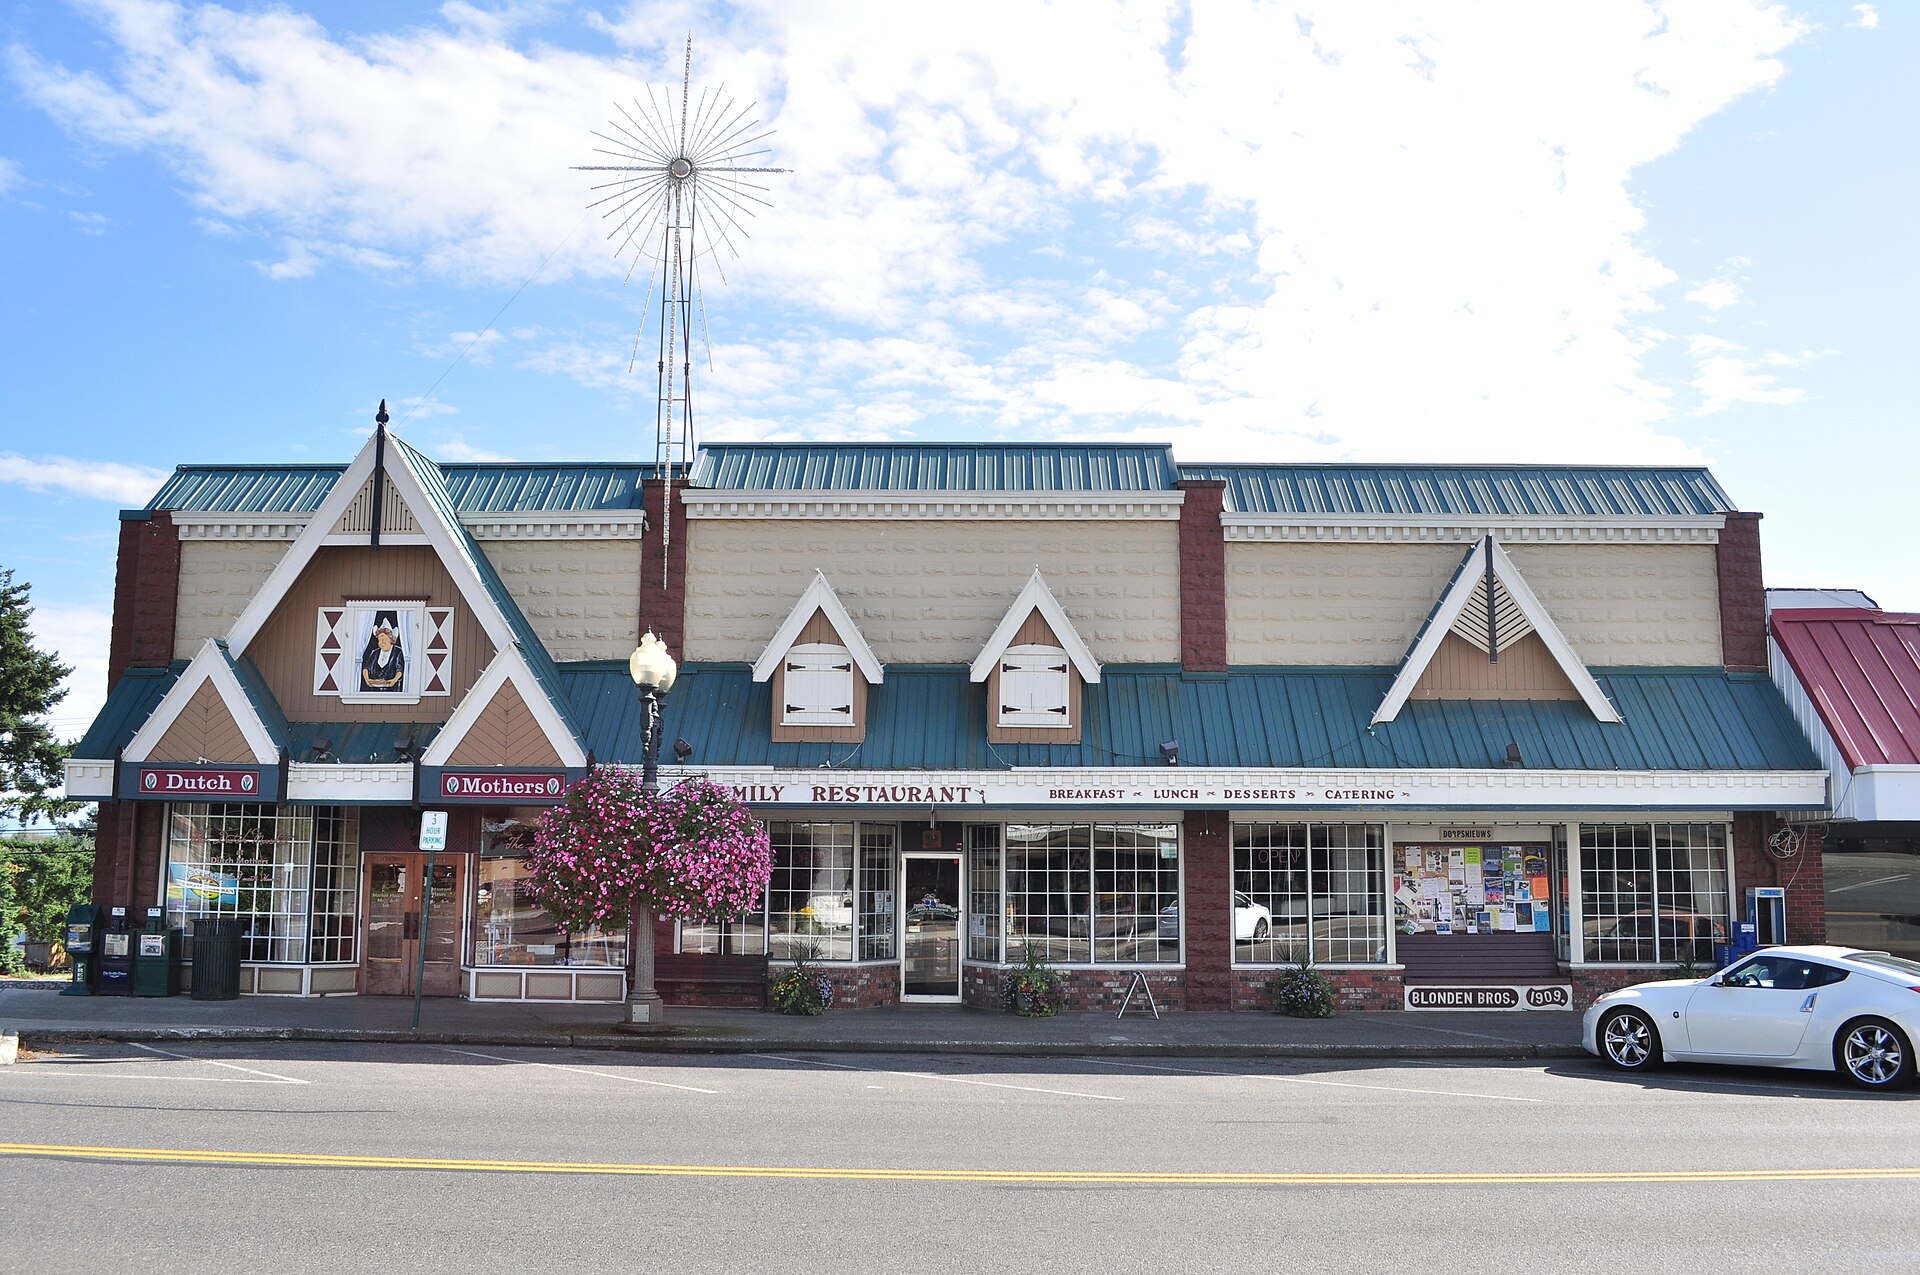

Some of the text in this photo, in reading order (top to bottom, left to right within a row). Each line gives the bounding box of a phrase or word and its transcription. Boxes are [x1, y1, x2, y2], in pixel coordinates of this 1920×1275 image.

[165, 773, 544, 794] Dutch Mothers
[731, 785, 972, 803] MILY RESTAURANT
[1049, 789, 1396, 800] BREAKFAST LUNCH DESSERTS CATERING
[431, 817, 437, 825] 3
[426, 827, 441, 835] HOUR
[422, 836, 443, 844] PARKING
[211, 856, 269, 864] Dutch Mothers
[1258, 849, 1298, 864] OPEN
[1412, 990, 1566, 1004] BLONDEN BROS. 1909.
